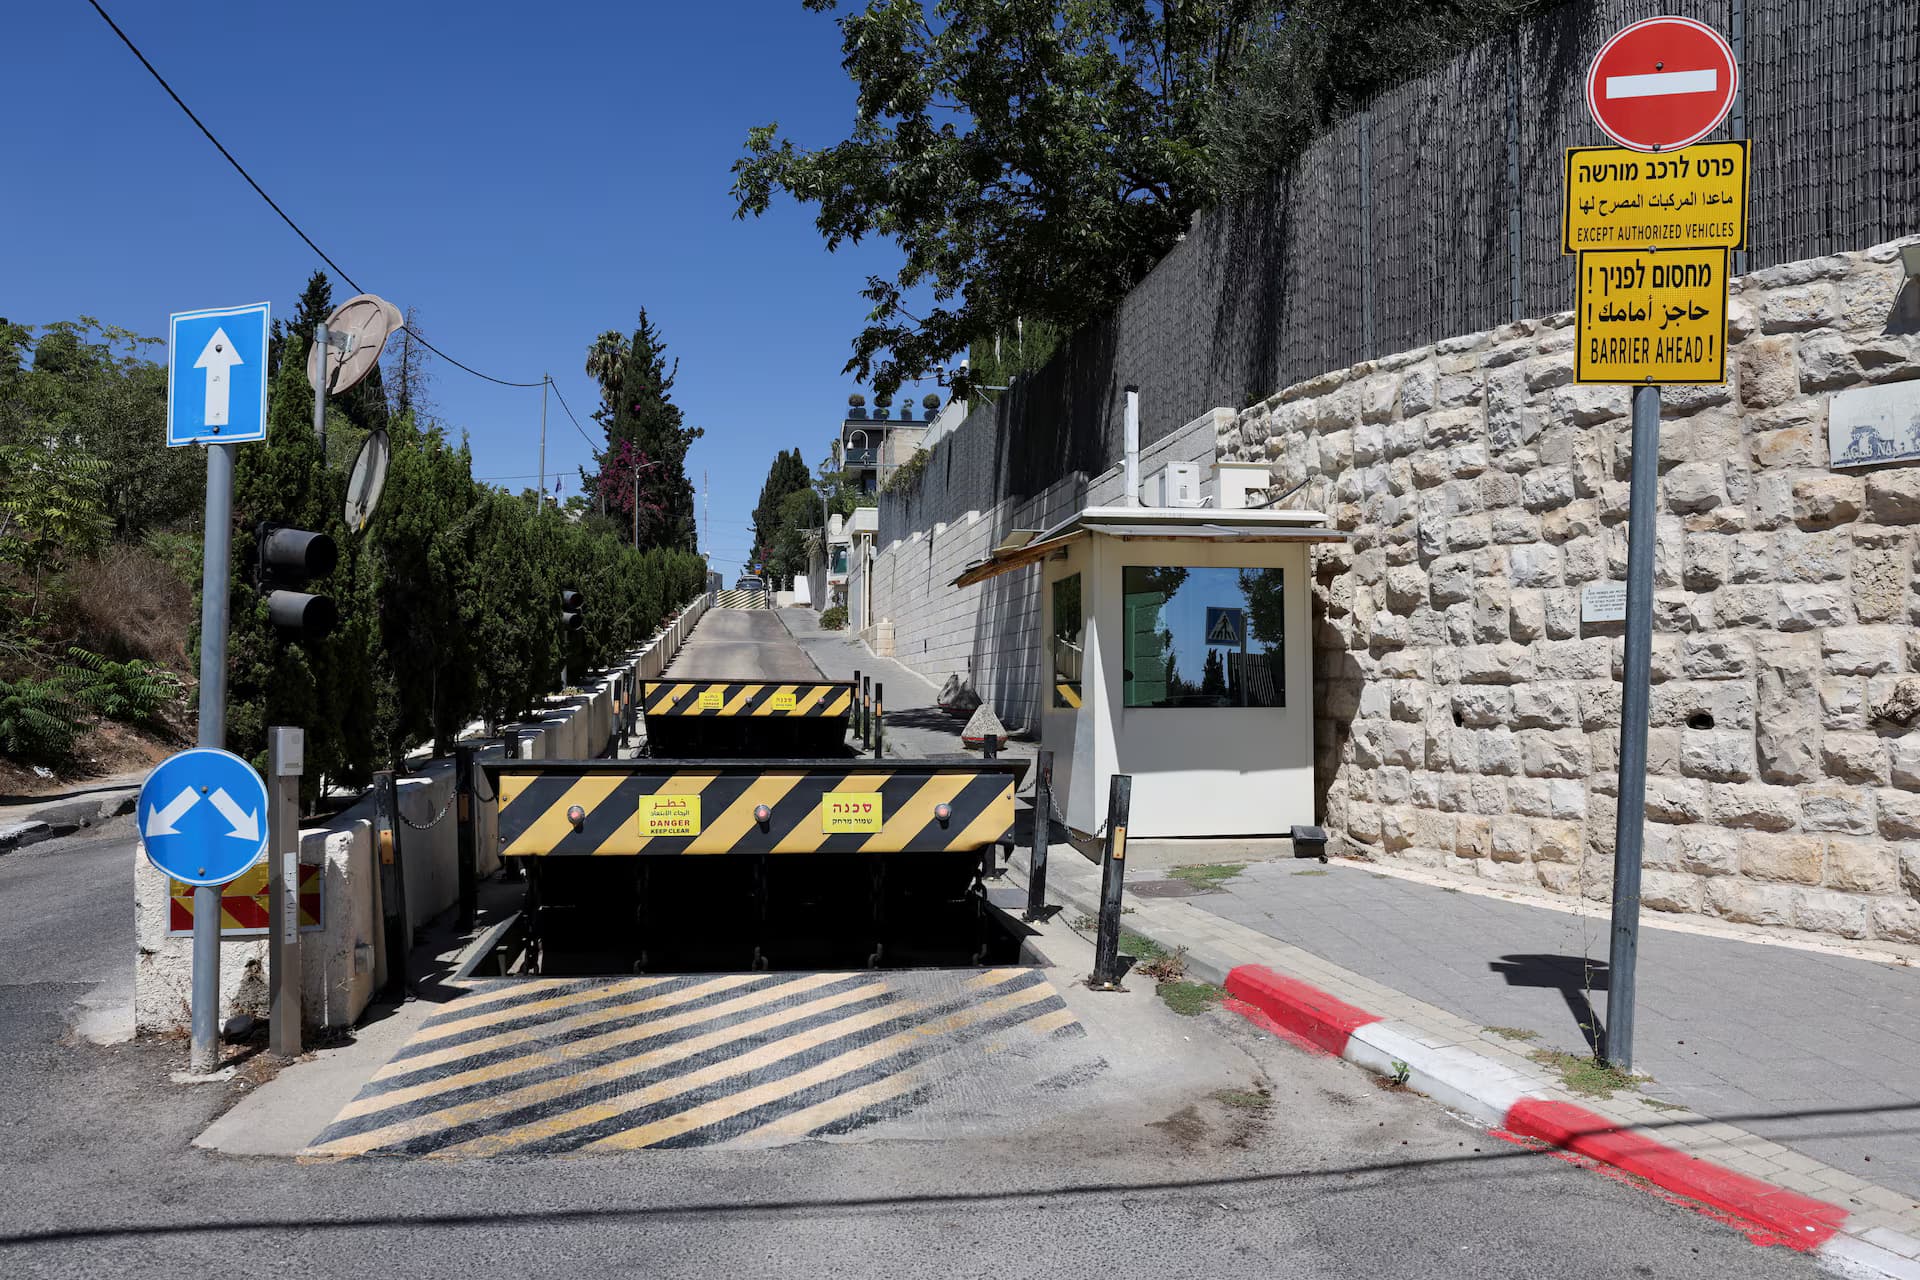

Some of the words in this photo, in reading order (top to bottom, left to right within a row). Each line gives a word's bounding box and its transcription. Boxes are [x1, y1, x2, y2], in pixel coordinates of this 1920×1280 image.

[1579, 163, 1639, 183] מורשה
[1646, 155, 1690, 180] לרכב
[1697, 158, 1735, 177] פרט
[1579, 196, 1595, 215] لها
[1599, 194, 1643, 216] المصرح
[1649, 191, 1697, 211] المركبات
[1578, 226, 1614, 242] EXCEPT
[1617, 224, 1682, 241] AUTHORIZED
[1686, 222, 1734, 239] VEHICLES
[1652, 263, 1712, 288] מחסום
[1658, 300, 1710, 330] حاجز
[1591, 337, 1650, 364] BARRIER
[653, 798, 687, 809] خطر
[832, 803, 872, 813] סכנה
